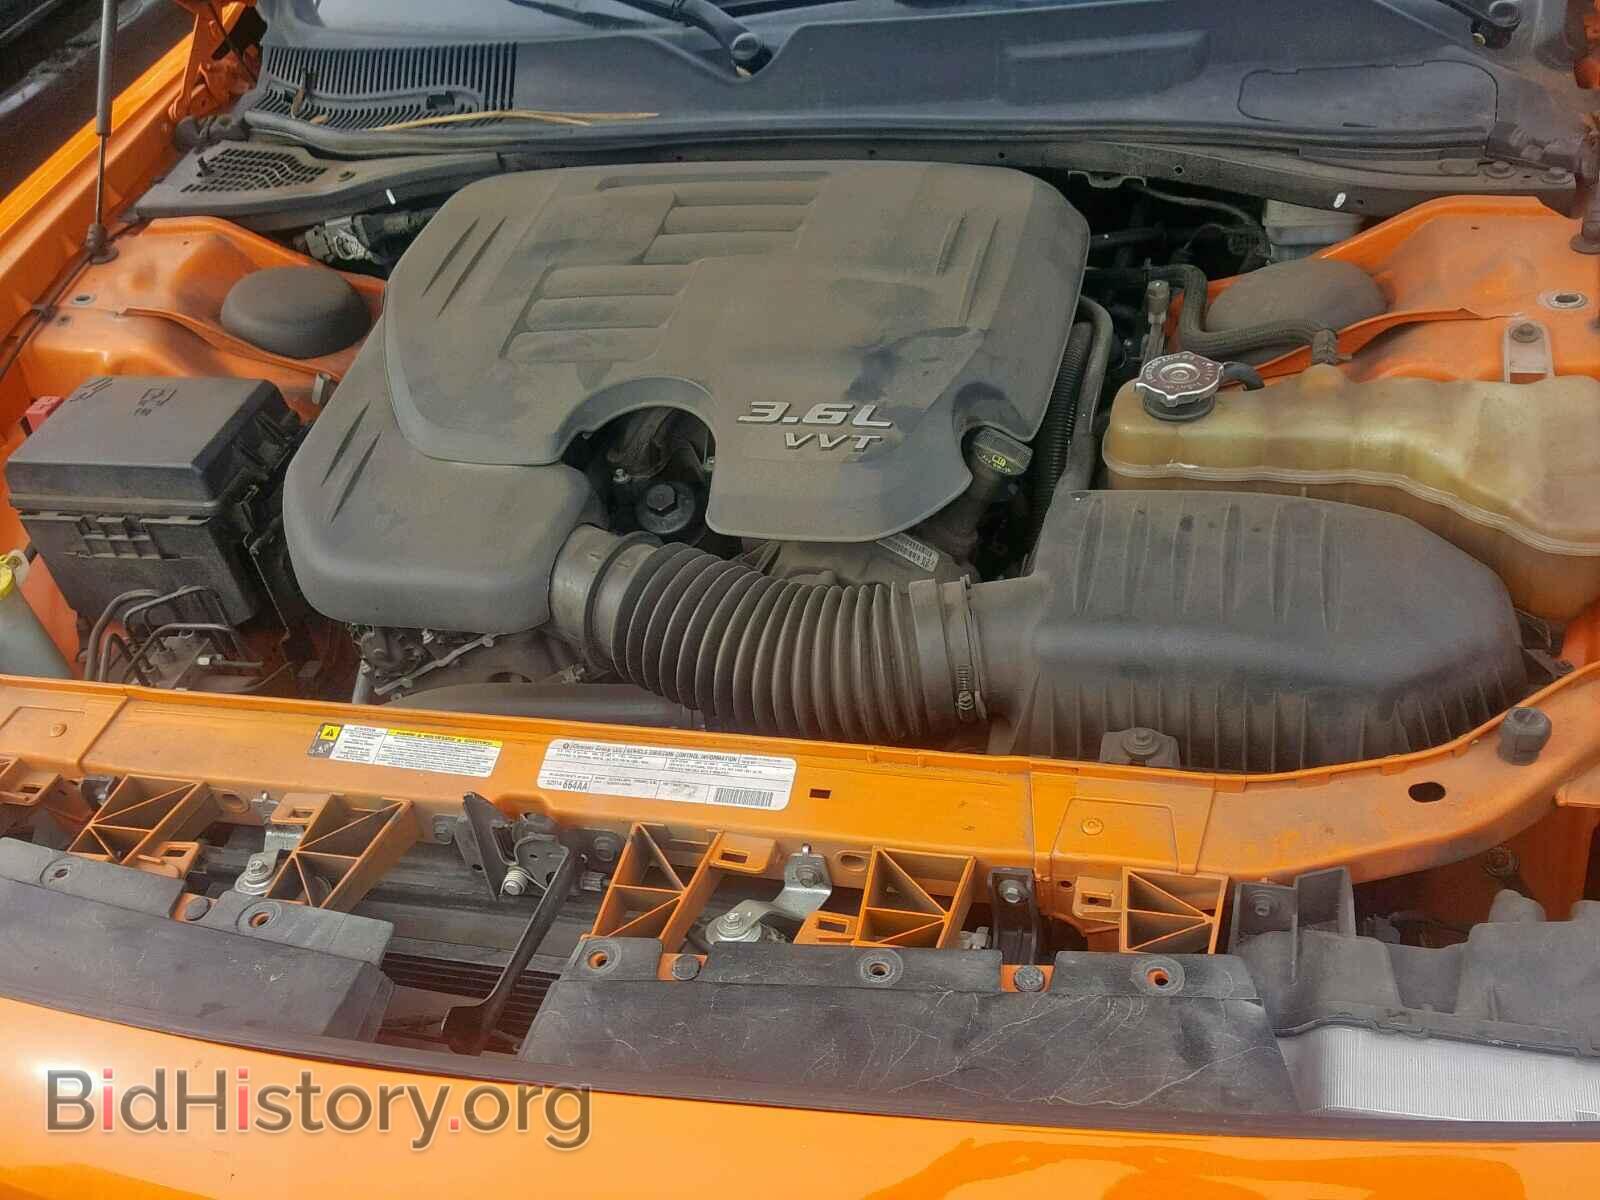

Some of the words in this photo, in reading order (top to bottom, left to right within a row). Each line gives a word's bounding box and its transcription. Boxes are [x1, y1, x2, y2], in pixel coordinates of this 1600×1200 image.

[736, 401, 893, 428] 3.6L
[784, 431, 882, 450] VVT
[675, 751, 699, 760] CONTROL
[701, 752, 737, 762] INFORMATION
